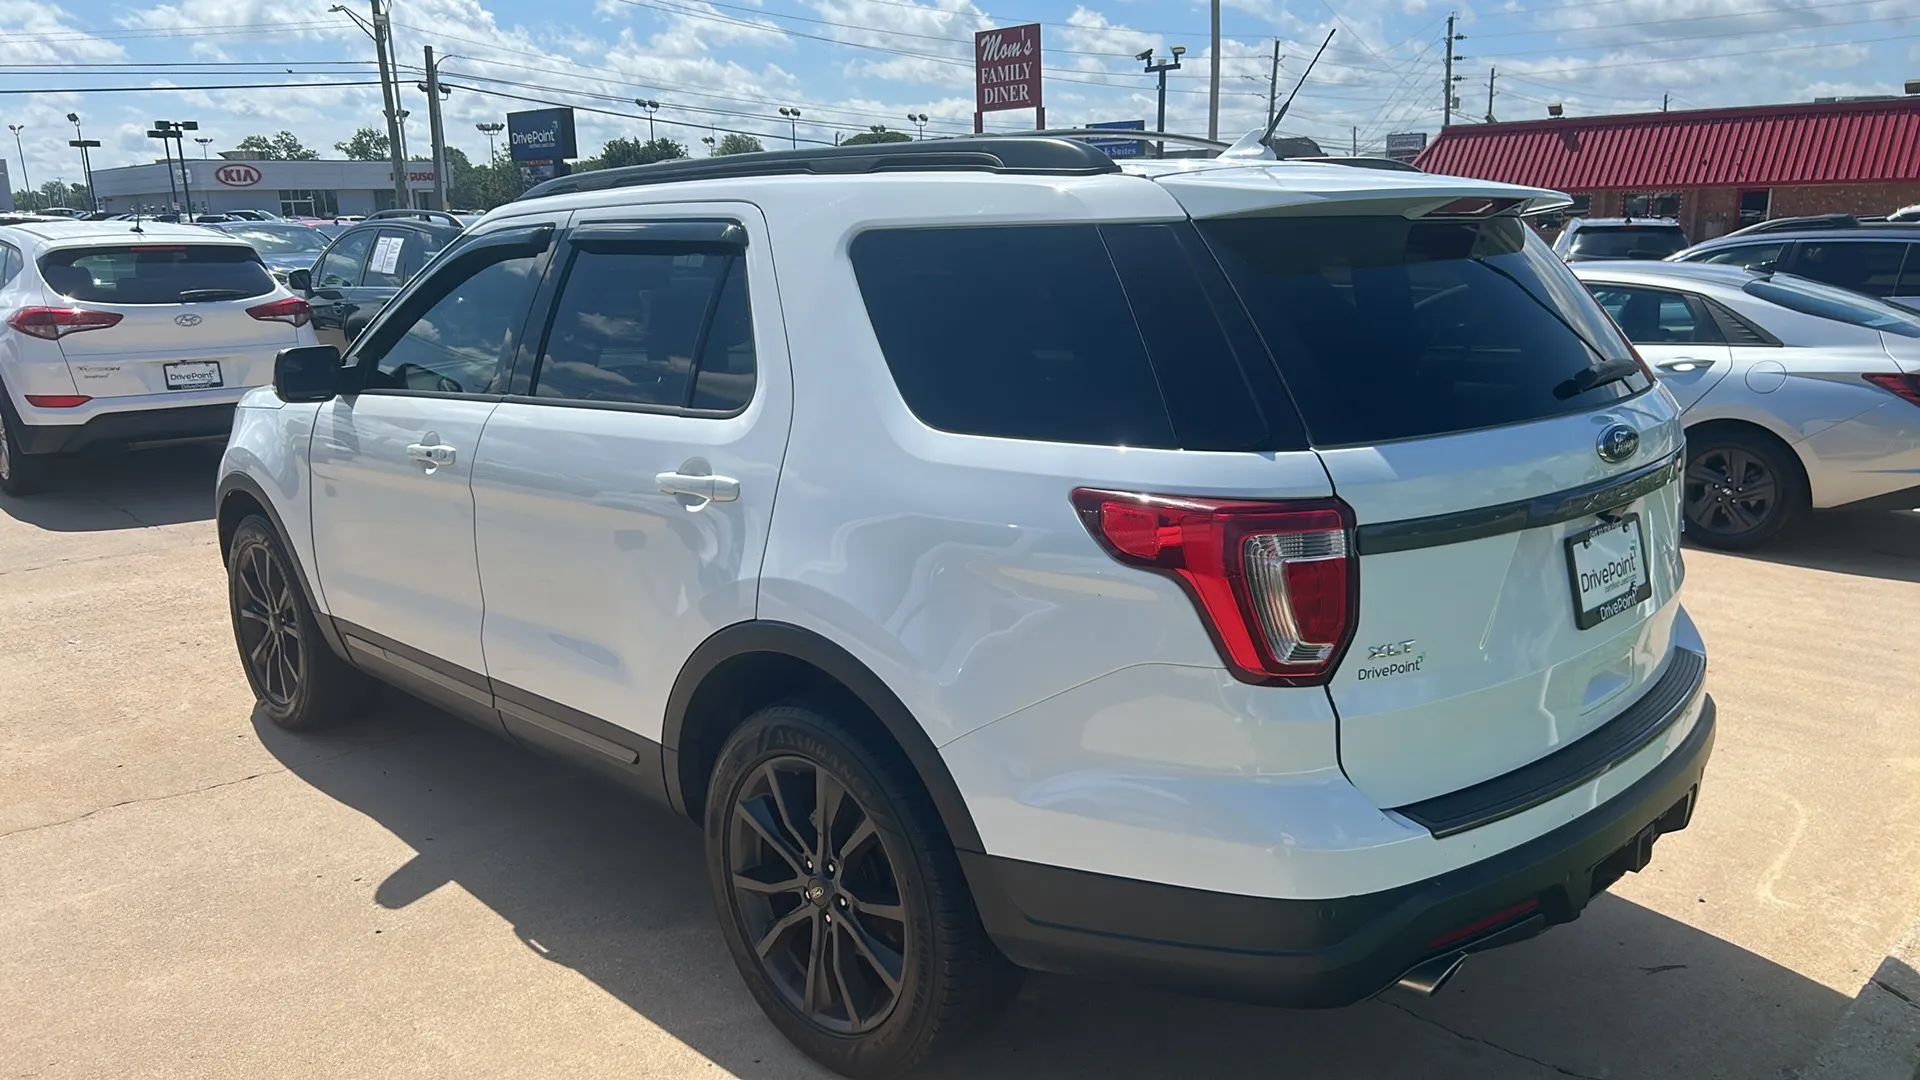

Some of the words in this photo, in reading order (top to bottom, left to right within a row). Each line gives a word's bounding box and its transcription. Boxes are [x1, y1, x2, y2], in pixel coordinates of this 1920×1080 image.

[981, 28, 1033, 61] Mom's
[981, 62, 1032, 84] FAMILY
[984, 83, 1029, 105] DINER
[512, 129, 555, 145] DrivePoint
[1111, 146, 1136, 156] Suites
[223, 169, 255, 182] KIA
[170, 372, 213, 381] DrivePoint
[1581, 552, 1636, 593] DrivePoint
[1600, 591, 1637, 620] DrivePoint
[1368, 639, 1416, 660] XLT
[1358, 660, 1420, 681] DrivePoint
